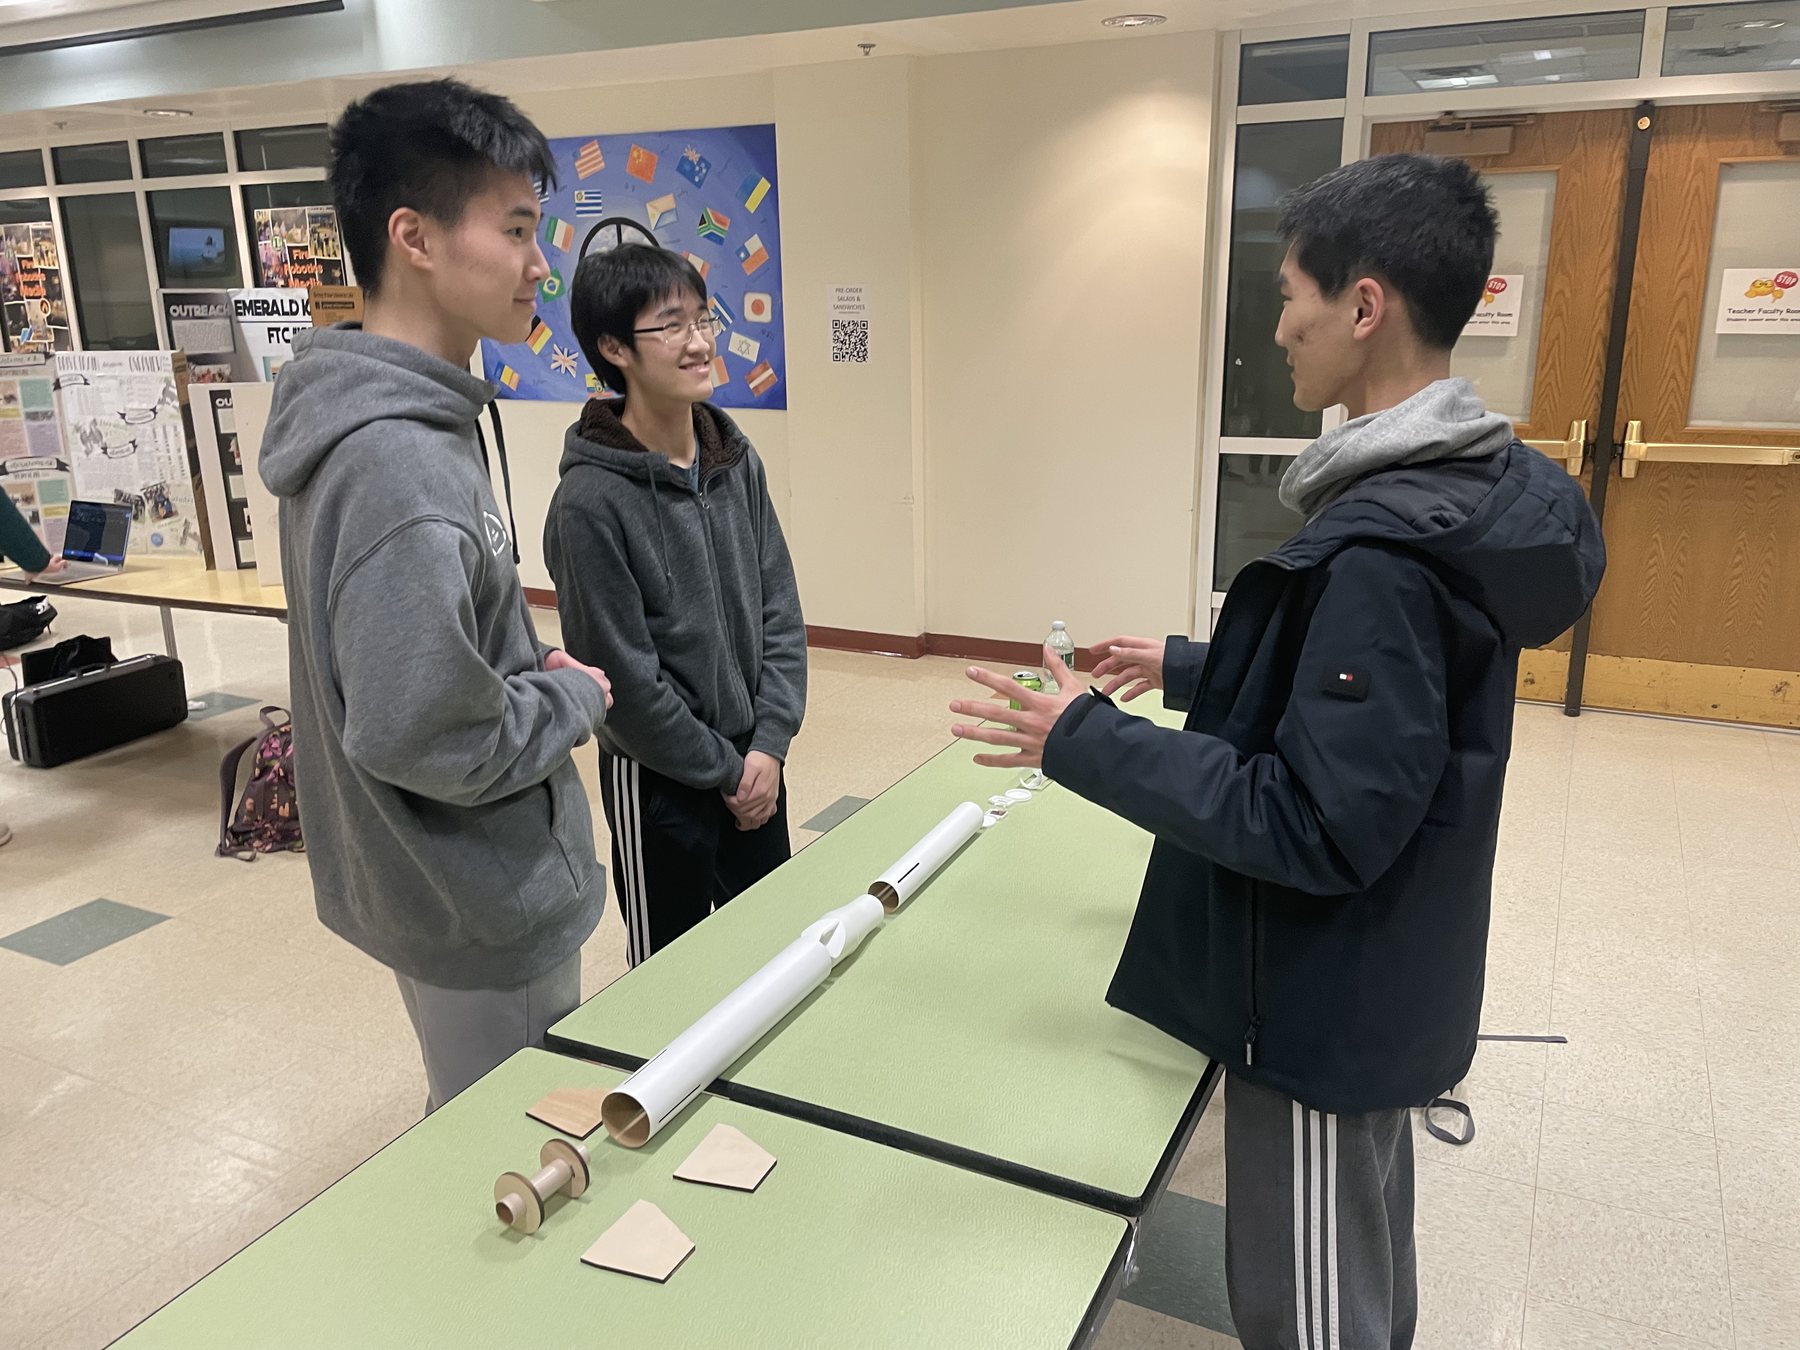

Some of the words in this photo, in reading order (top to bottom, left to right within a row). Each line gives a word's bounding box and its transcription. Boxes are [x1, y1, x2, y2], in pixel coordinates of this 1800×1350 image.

[283, 262, 324, 276] Robotics
[1488, 280, 1506, 291] STOP
[1776, 274, 1797, 286] STOP
[169, 303, 230, 318] OUTREACH
[234, 299, 300, 317] EMERALD
[1757, 307, 1784, 316] Faculty
[1474, 311, 1495, 319] aculty
[267, 327, 291, 344] FTC
